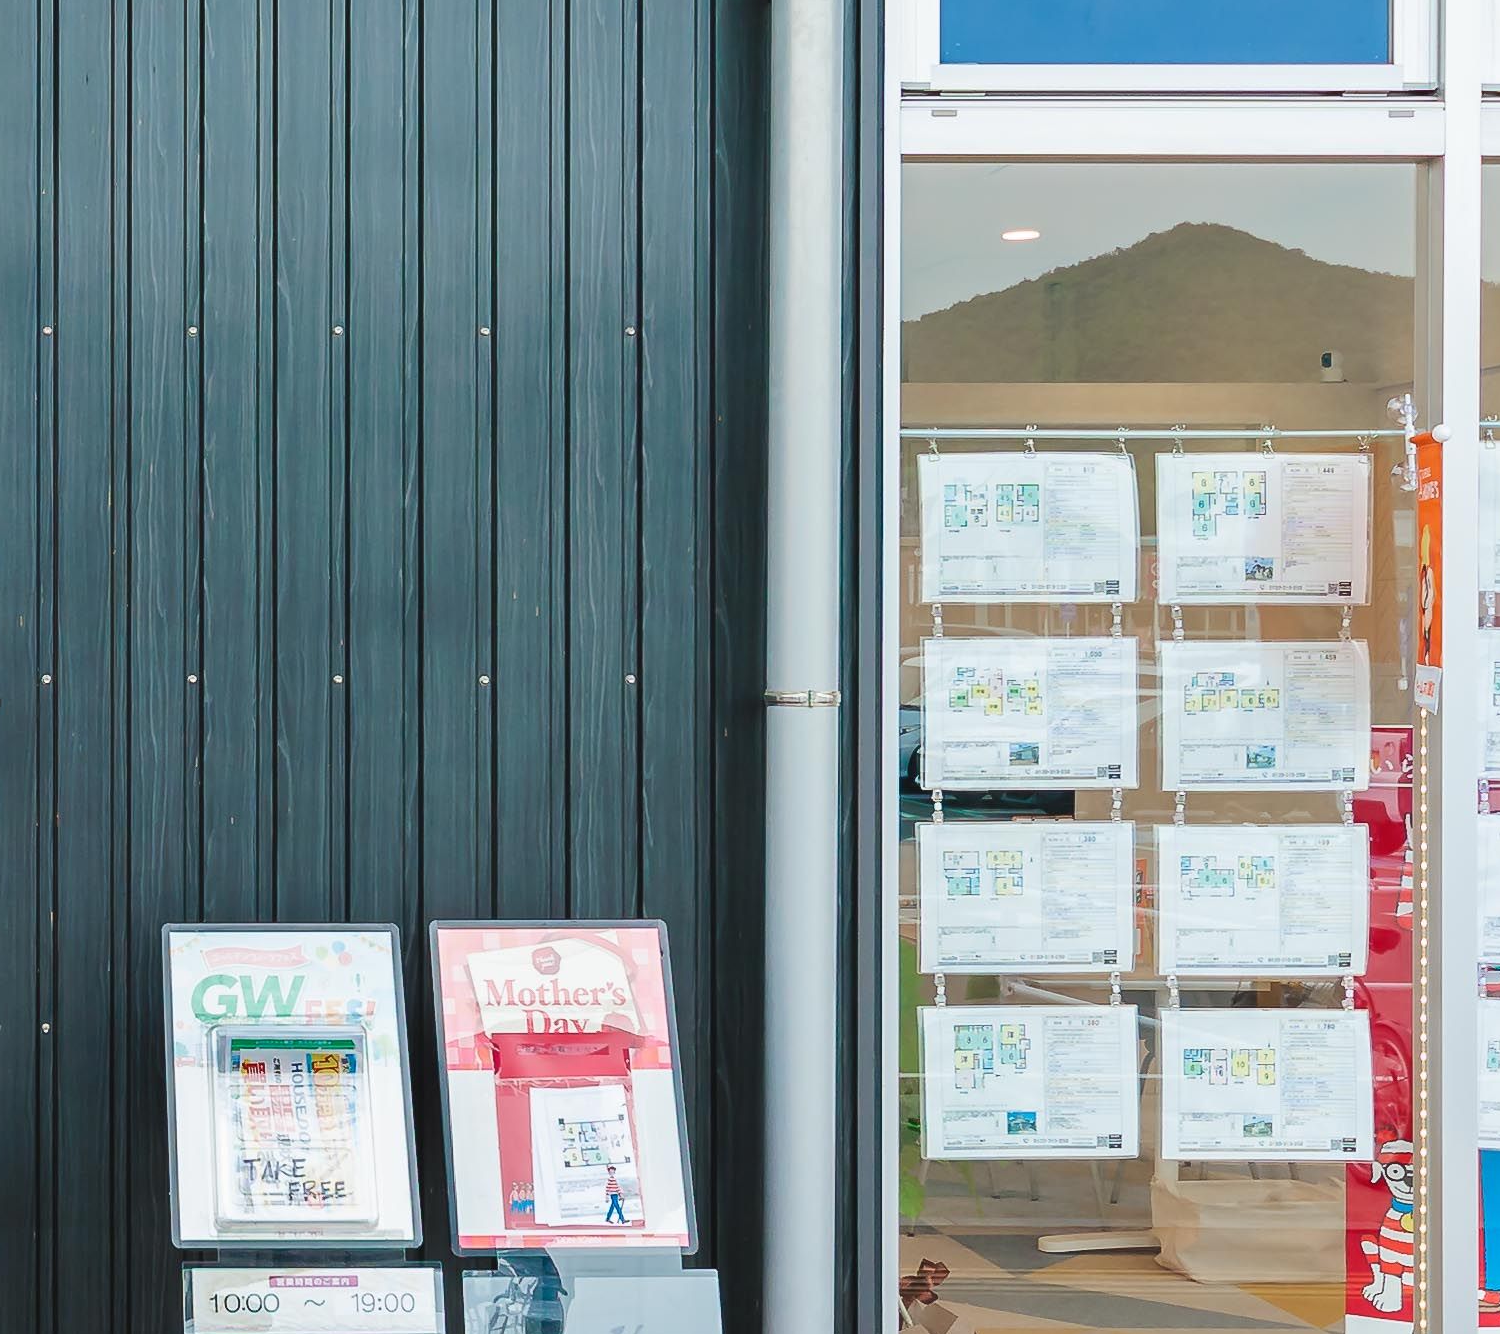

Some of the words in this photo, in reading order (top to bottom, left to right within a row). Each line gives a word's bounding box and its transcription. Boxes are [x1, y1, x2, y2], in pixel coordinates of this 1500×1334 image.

[190, 973, 306, 1025] GW
[483, 978, 627, 1007] Mother's
[243, 1158, 307, 1181] TAKE
[288, 1179, 347, 1201] FREE
[276, 1276, 351, 1287] 営業時間のご案内
[209, 1293, 280, 1313] 10:00
[351, 1292, 416, 1313] 19:00
